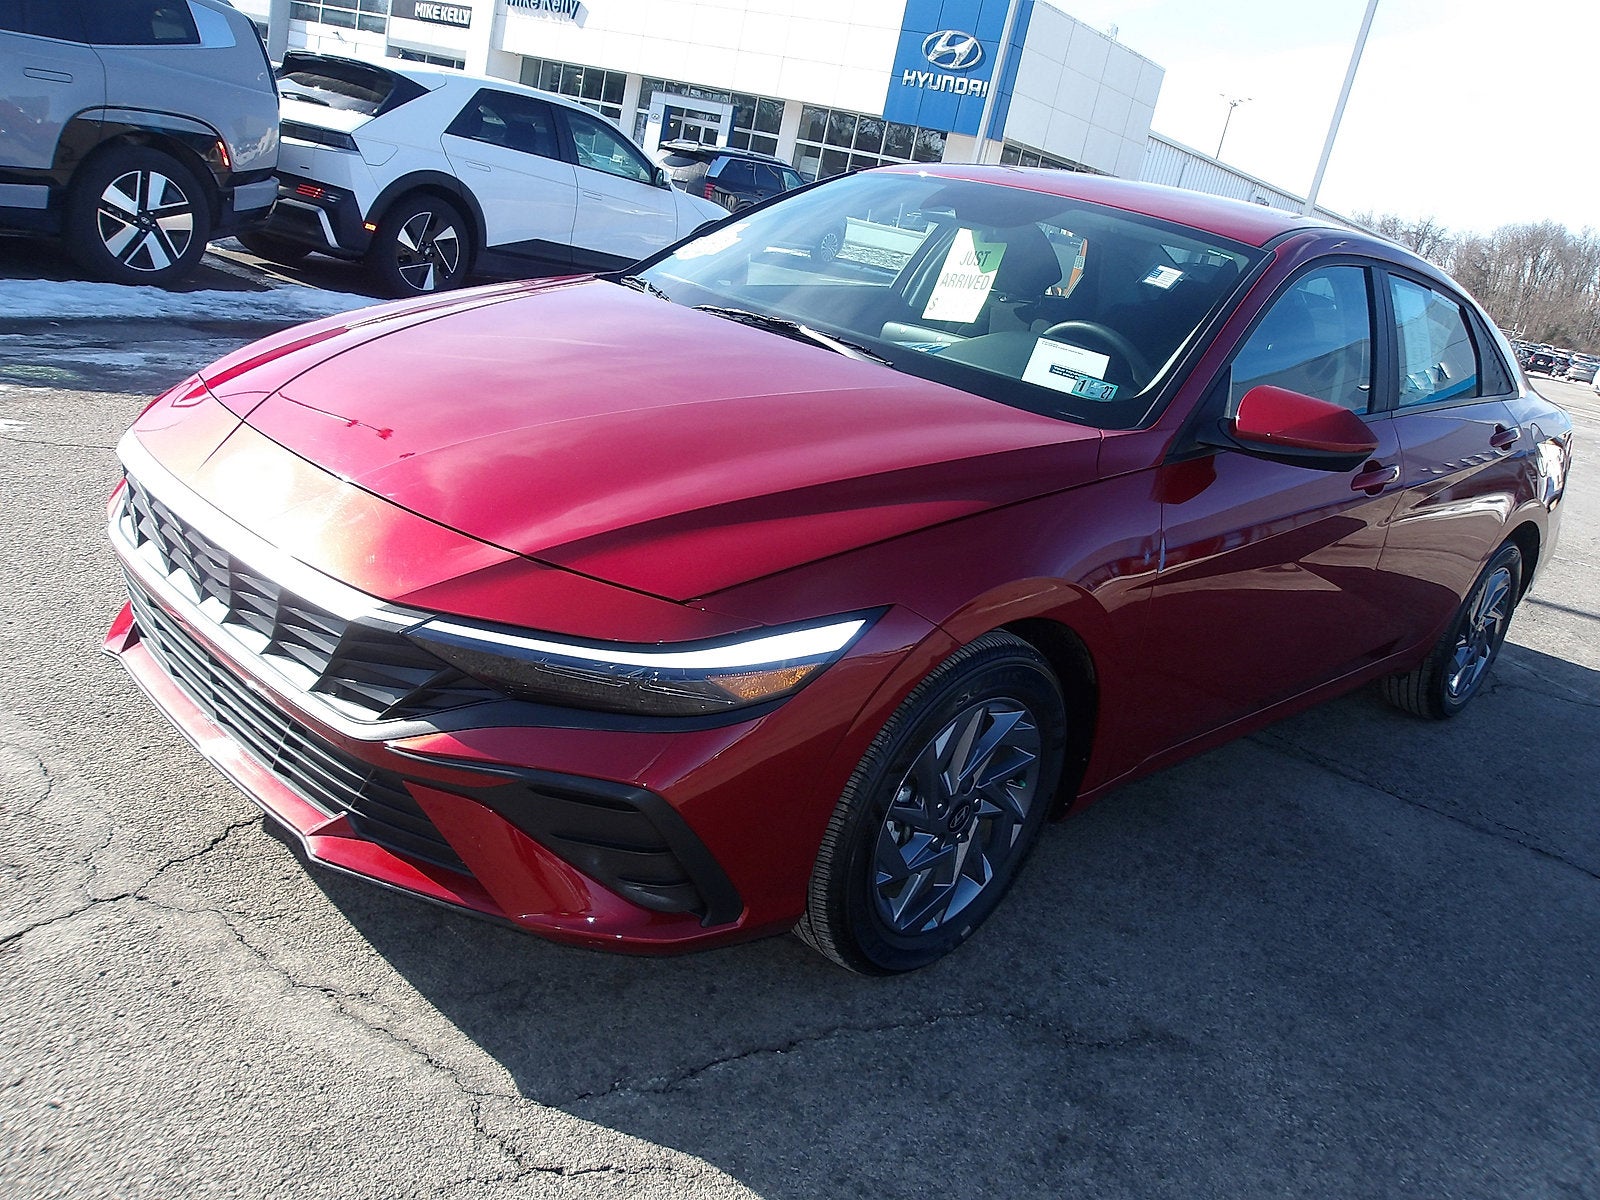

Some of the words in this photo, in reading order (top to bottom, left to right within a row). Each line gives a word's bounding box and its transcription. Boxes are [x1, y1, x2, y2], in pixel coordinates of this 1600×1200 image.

[414, 1, 441, 20] MIKE
[440, 5, 471, 25] KELLY
[902, 69, 988, 98] HYUNDAI
[959, 250, 991, 267] JUST
[939, 272, 990, 291] ARRIVED
[1078, 379, 1087, 393] 1
[1100, 385, 1115, 400] 27
